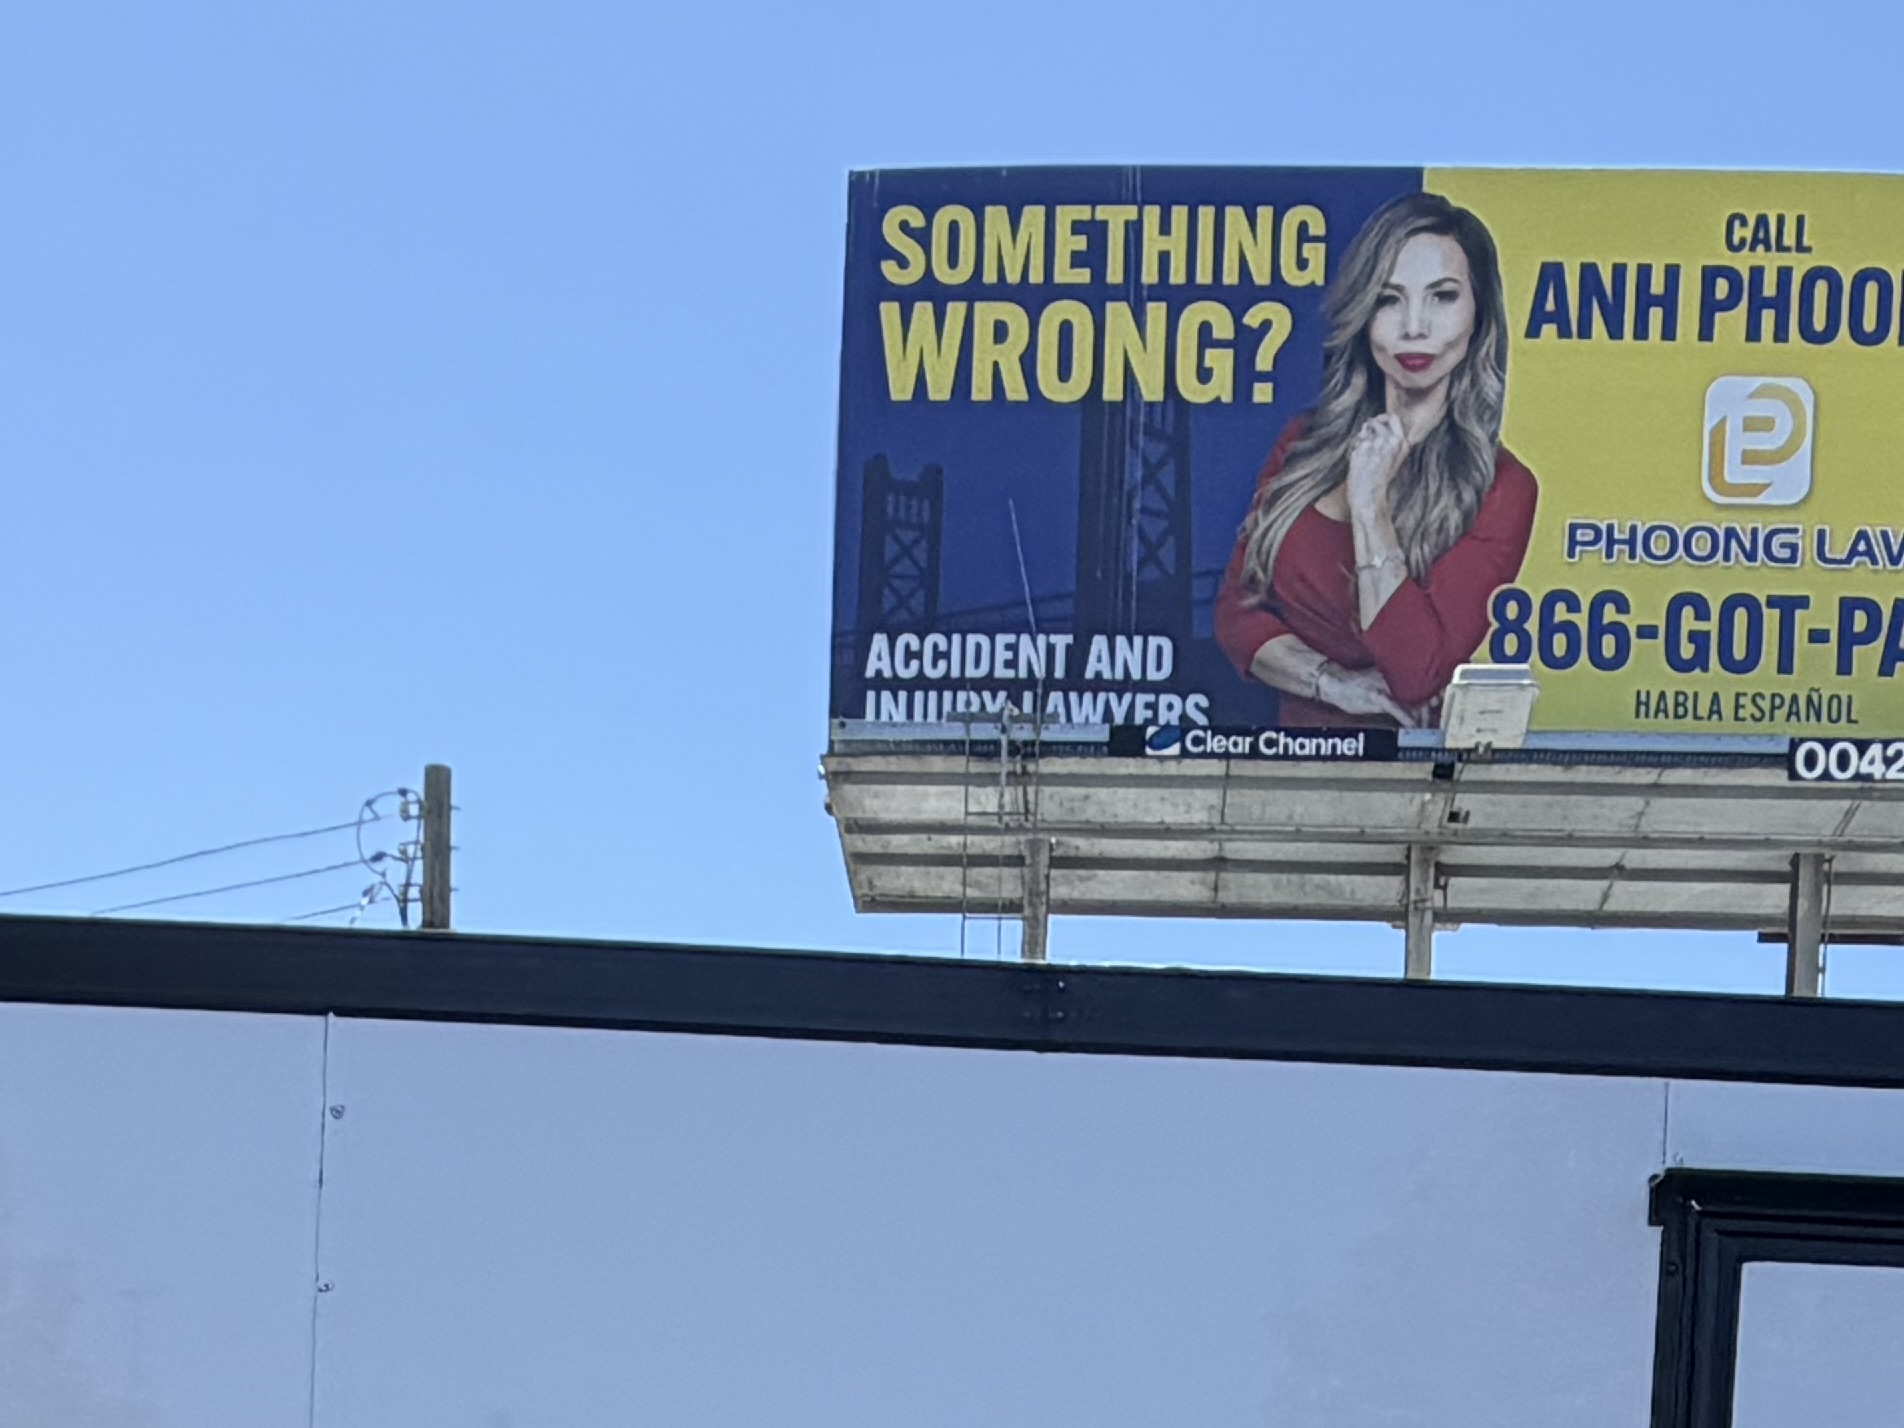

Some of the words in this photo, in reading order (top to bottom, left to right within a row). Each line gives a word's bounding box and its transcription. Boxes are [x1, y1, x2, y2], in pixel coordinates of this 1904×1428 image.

[880, 204, 1327, 287] SOMETHING
[1724, 212, 1813, 254] CALL
[1524, 260, 1682, 342] ANH
[879, 299, 1294, 404] WRONG?
[1565, 520, 1802, 567] PHOONG
[864, 632, 1074, 680] ACCIDENT
[1084, 633, 1174, 682] AND
[1634, 689, 1724, 722] HABLA
[1733, 686, 1860, 725] ESPAÑOL
[1184, 729, 1254, 754] Clear
[1258, 730, 1365, 757] Channel
